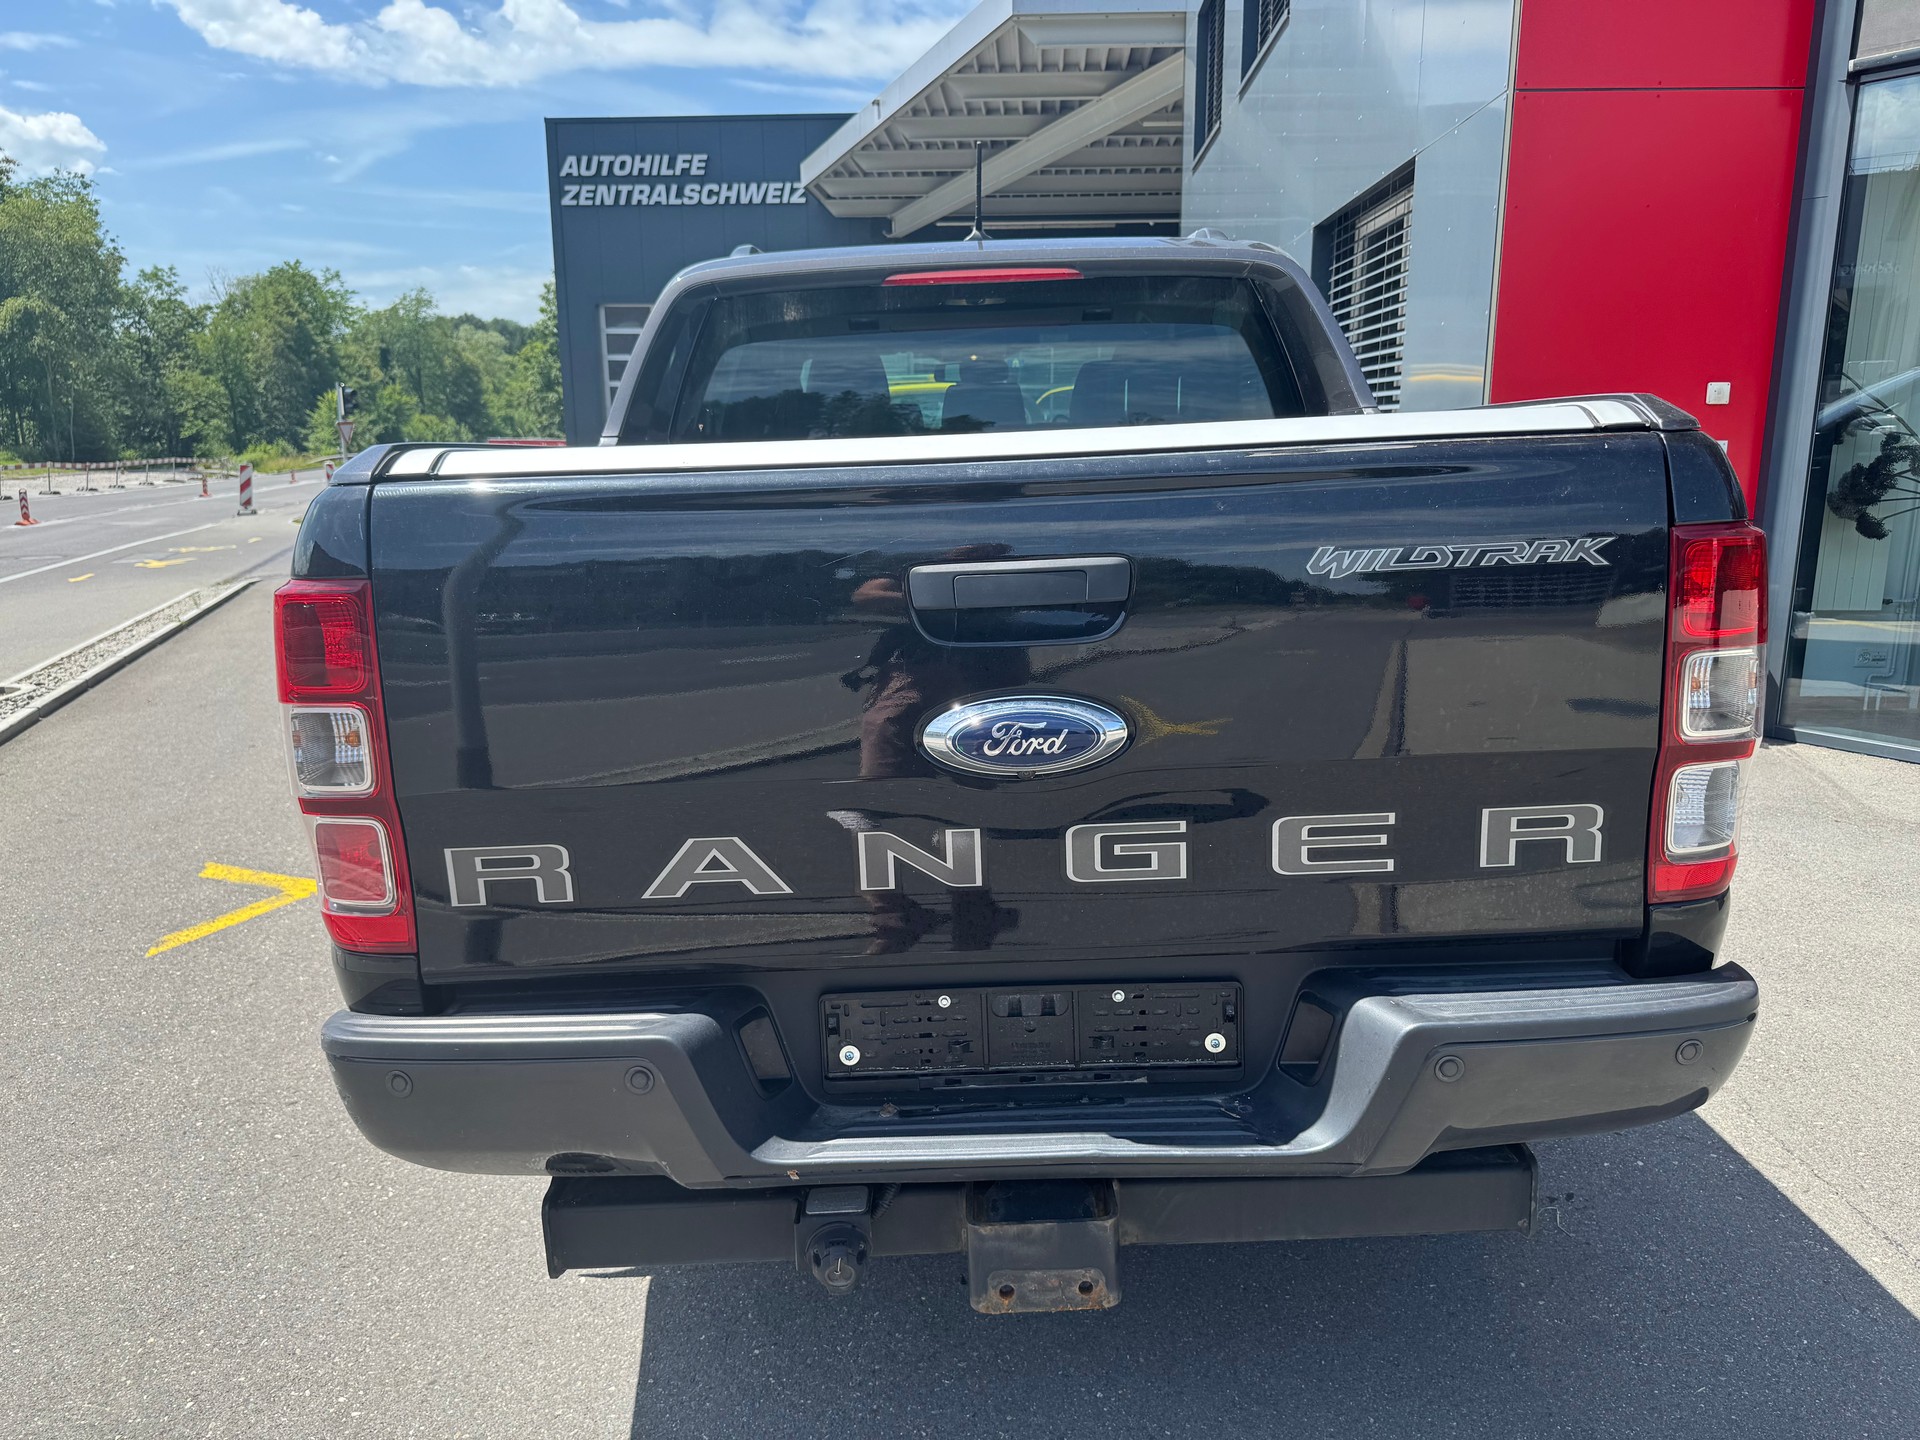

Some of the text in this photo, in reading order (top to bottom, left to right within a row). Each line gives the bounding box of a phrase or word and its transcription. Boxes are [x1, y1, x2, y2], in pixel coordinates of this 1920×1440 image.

[560, 154, 708, 177] AUTOHILFE
[561, 181, 807, 206] ZENTRALSCHWEIZ
[1306, 536, 1616, 578] WILDTRAK
[983, 721, 1068, 757] Ford
[443, 803, 1604, 907] RANGER
